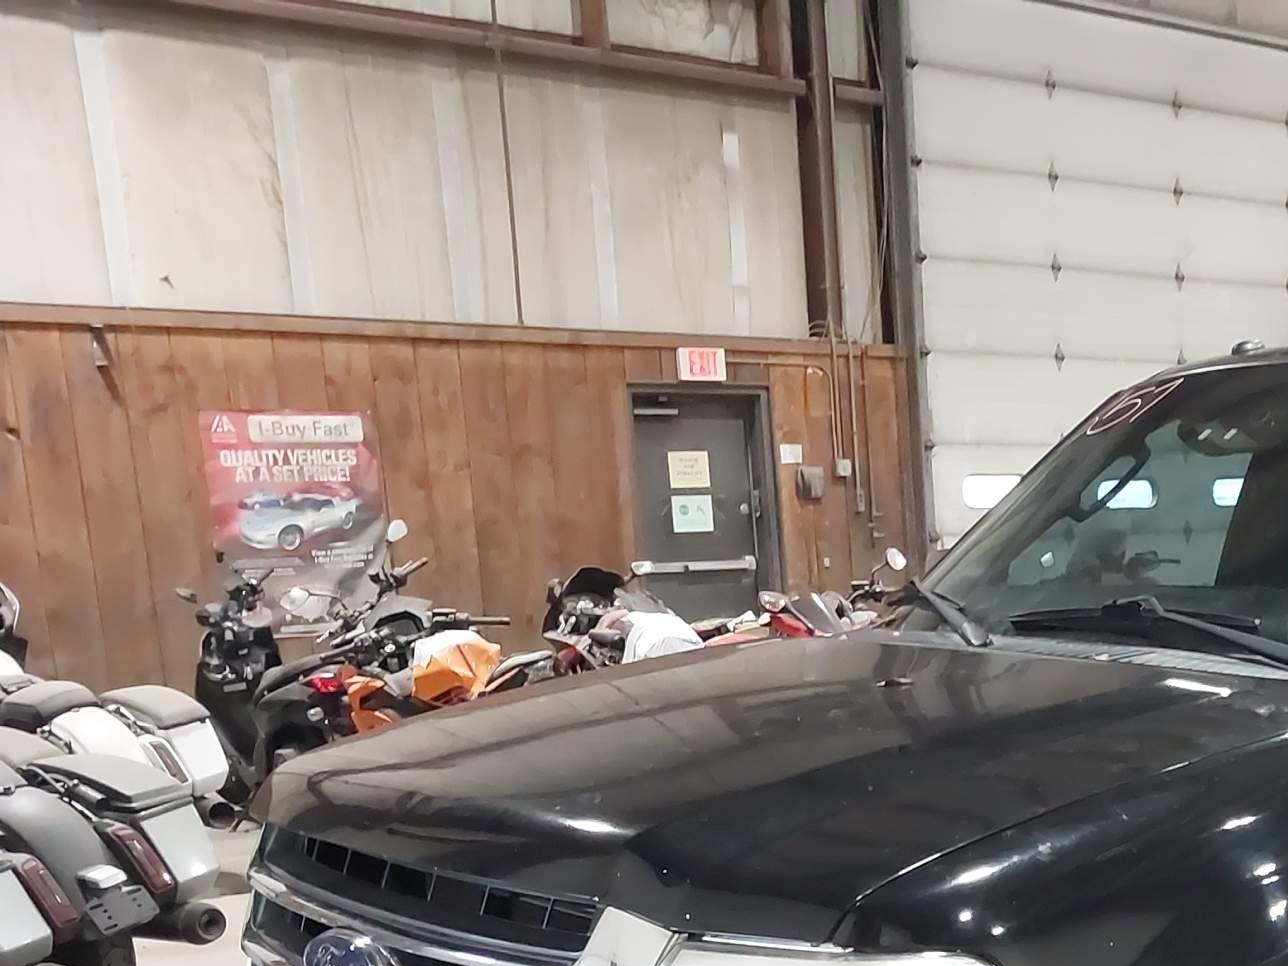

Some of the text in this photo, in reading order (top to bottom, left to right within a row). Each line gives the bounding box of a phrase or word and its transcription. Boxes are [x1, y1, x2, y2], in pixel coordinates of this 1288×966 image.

[688, 350, 718, 378] EXIT
[258, 420, 306, 439] I-Buy
[312, 420, 349, 437] Fast
[219, 448, 357, 467] QUALITY VEHICLES
[235, 465, 351, 483] AT A SET PRICE!
